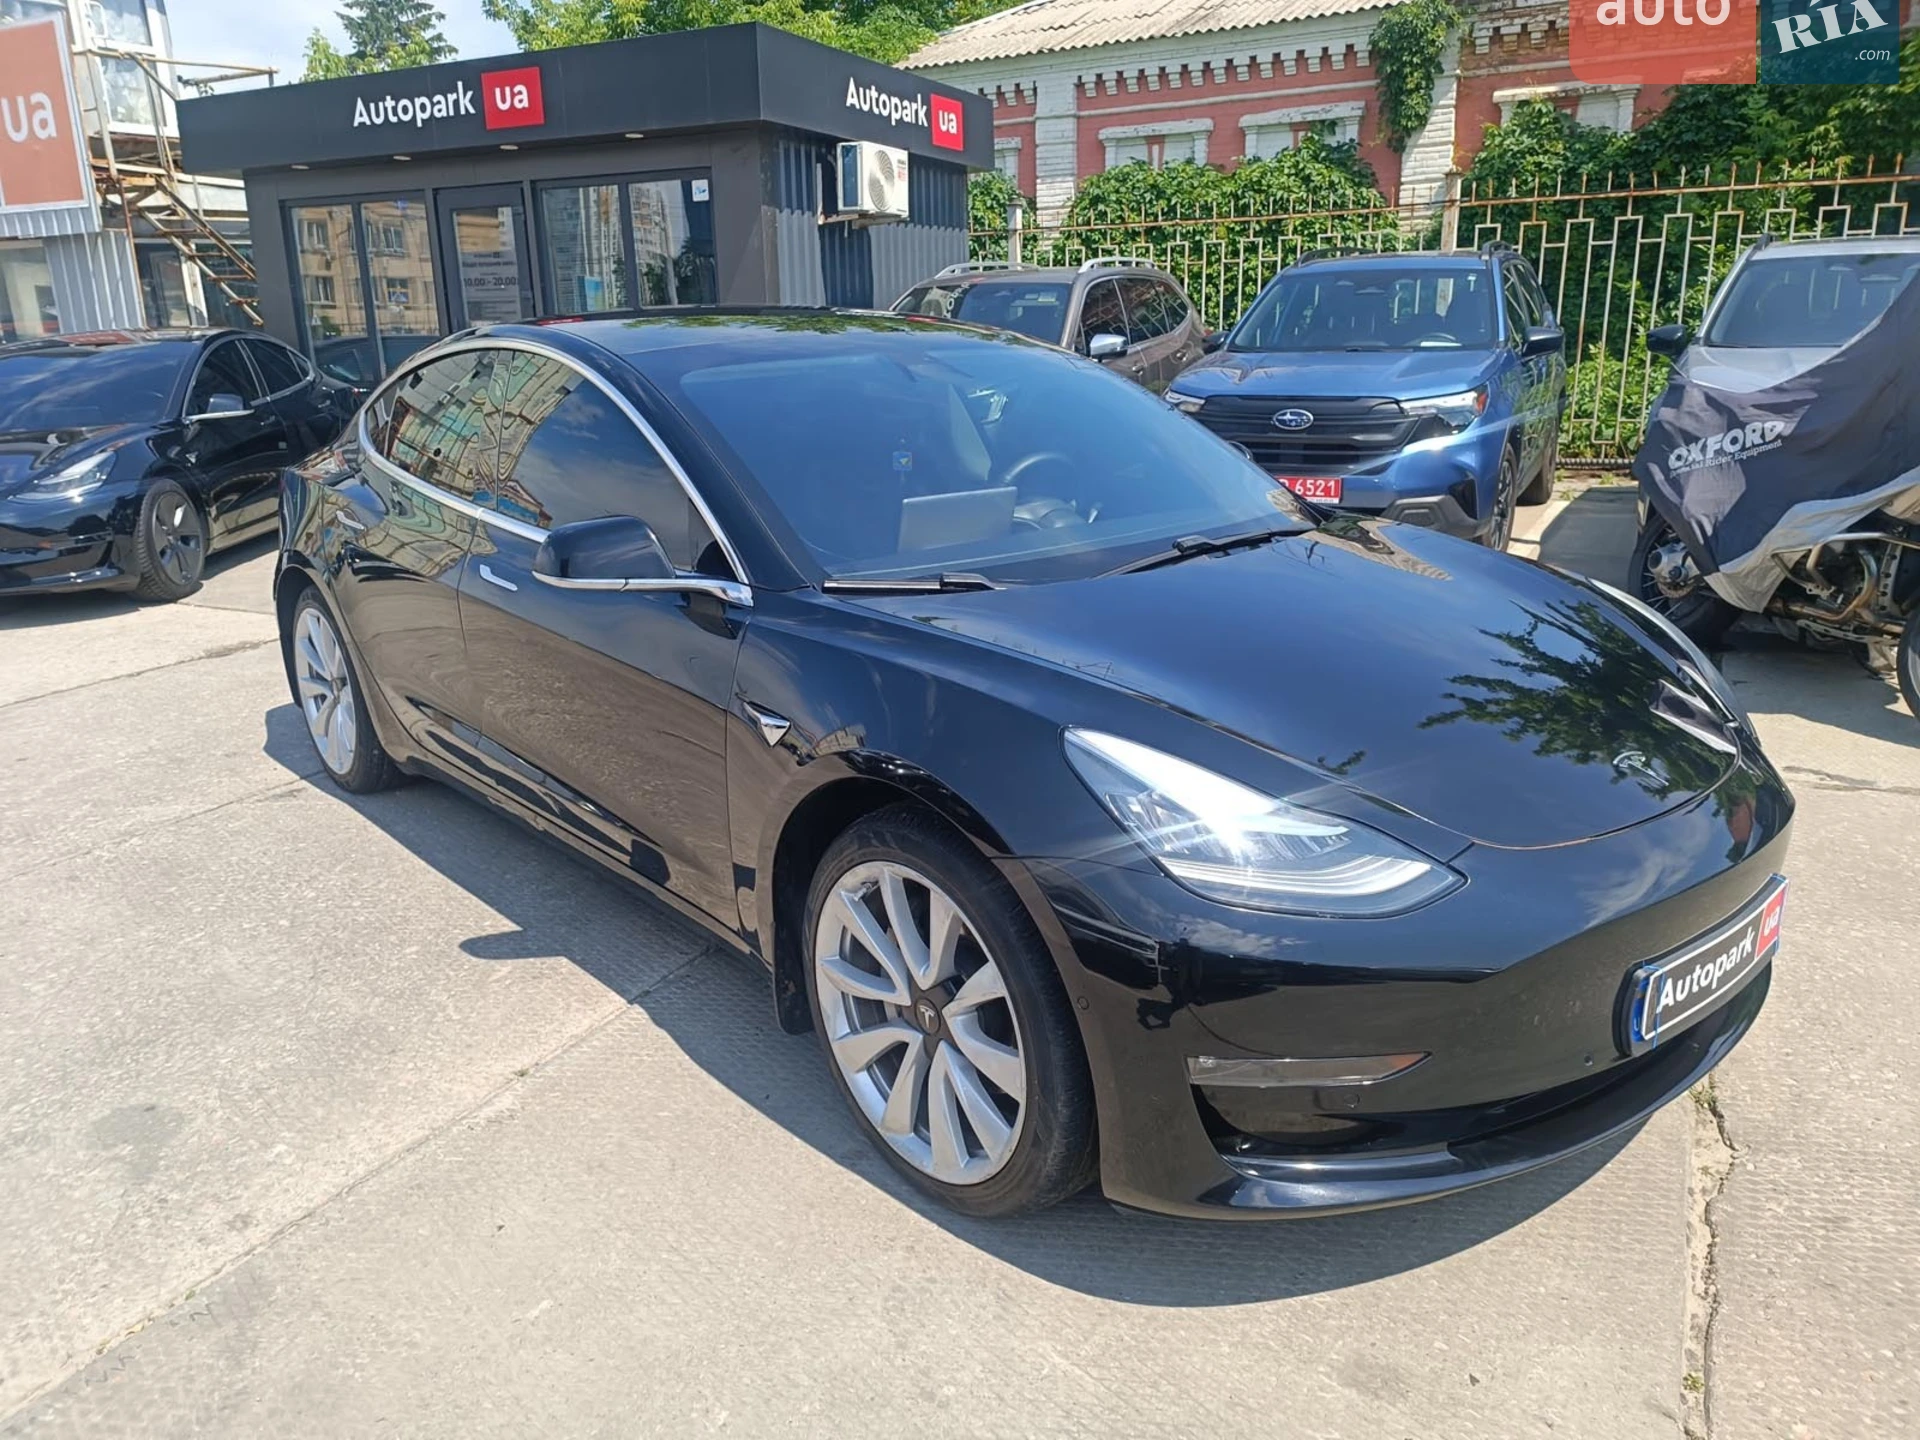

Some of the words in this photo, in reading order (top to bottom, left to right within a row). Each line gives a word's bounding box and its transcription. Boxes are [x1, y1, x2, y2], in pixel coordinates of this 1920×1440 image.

[0, 91, 57, 143] ua
[353, 81, 476, 128] Autopark
[494, 84, 529, 111] ua
[846, 76, 929, 127] Autopark
[938, 109, 958, 134] ua
[1668, 421, 1785, 470] OXFORD
[1734, 439, 1783, 461] Equipment
[1295, 479, 1336, 496] 6521
[1656, 927, 1756, 1014] Autopark
[1764, 906, 1780, 937] ua
